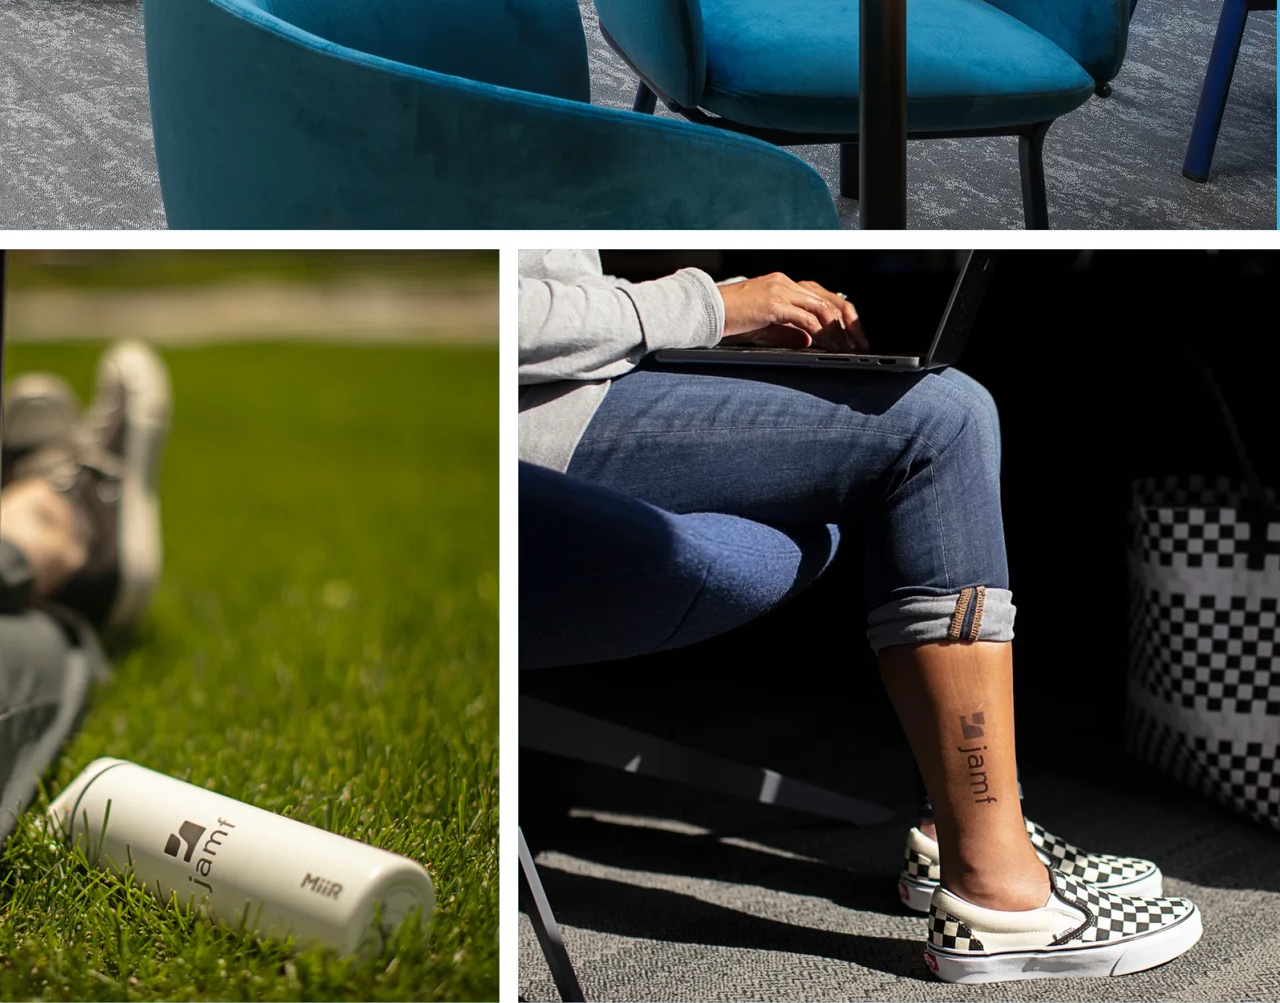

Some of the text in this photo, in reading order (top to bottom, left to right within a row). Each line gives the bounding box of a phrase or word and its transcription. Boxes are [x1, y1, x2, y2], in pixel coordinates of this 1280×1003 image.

[958, 746, 997, 804] jamf
[188, 816, 236, 894] jamf
[300, 872, 344, 901] MiiR
